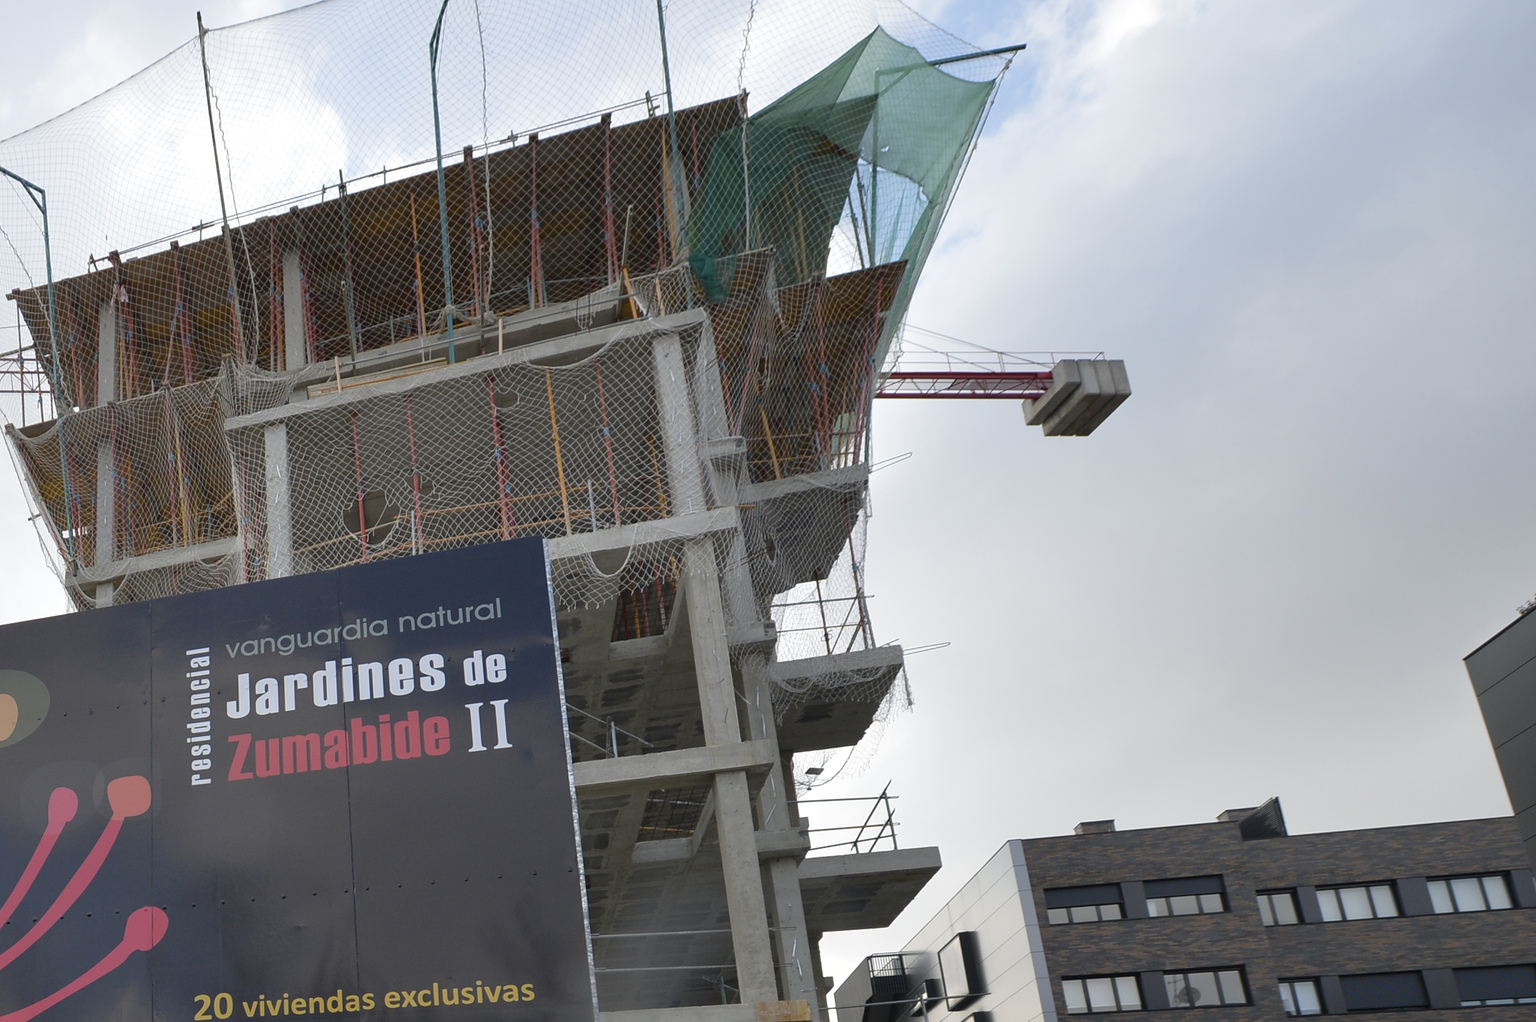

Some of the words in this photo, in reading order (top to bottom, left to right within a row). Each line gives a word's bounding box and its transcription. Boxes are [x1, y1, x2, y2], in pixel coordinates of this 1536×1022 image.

[225, 618, 389, 659] vanguardia
[399, 597, 502, 635] natural
[185, 646, 212, 786] residencial
[226, 653, 446, 720] Jardines
[463, 649, 508, 687] de
[227, 710, 451, 782] Zumabide
[465, 698, 513, 753] II
[193, 992, 234, 1022] 20
[242, 989, 375, 1018] viviendas
[384, 979, 536, 1010] exclusivas
